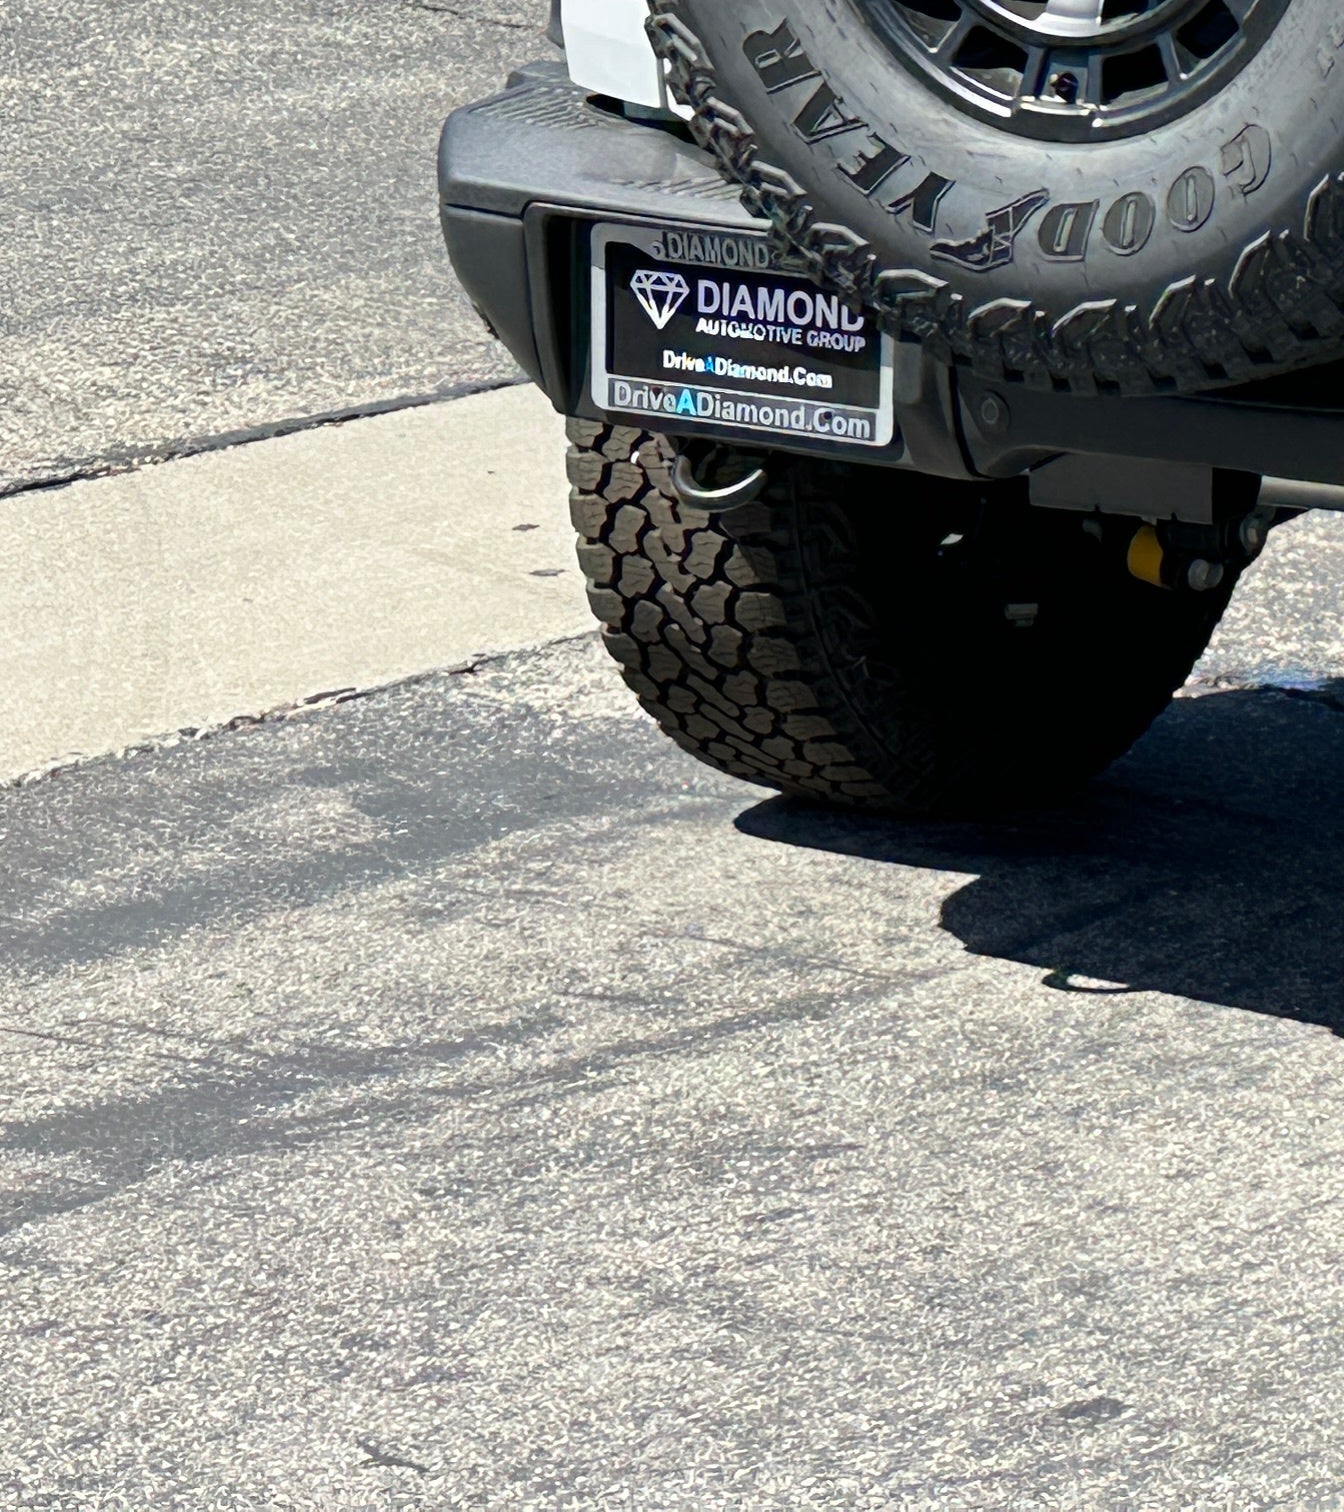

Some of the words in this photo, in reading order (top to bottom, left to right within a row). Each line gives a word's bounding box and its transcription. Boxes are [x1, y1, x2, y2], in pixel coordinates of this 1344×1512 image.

[664, 231, 770, 268] DIAMOND
[697, 279, 866, 332] DIAMOND
[695, 316, 803, 346] AUTOMOTIVE
[806, 329, 866, 354] GROUP
[662, 349, 833, 389] DriveADiamond.Com
[613, 379, 871, 439] DriveADiamond.Com
